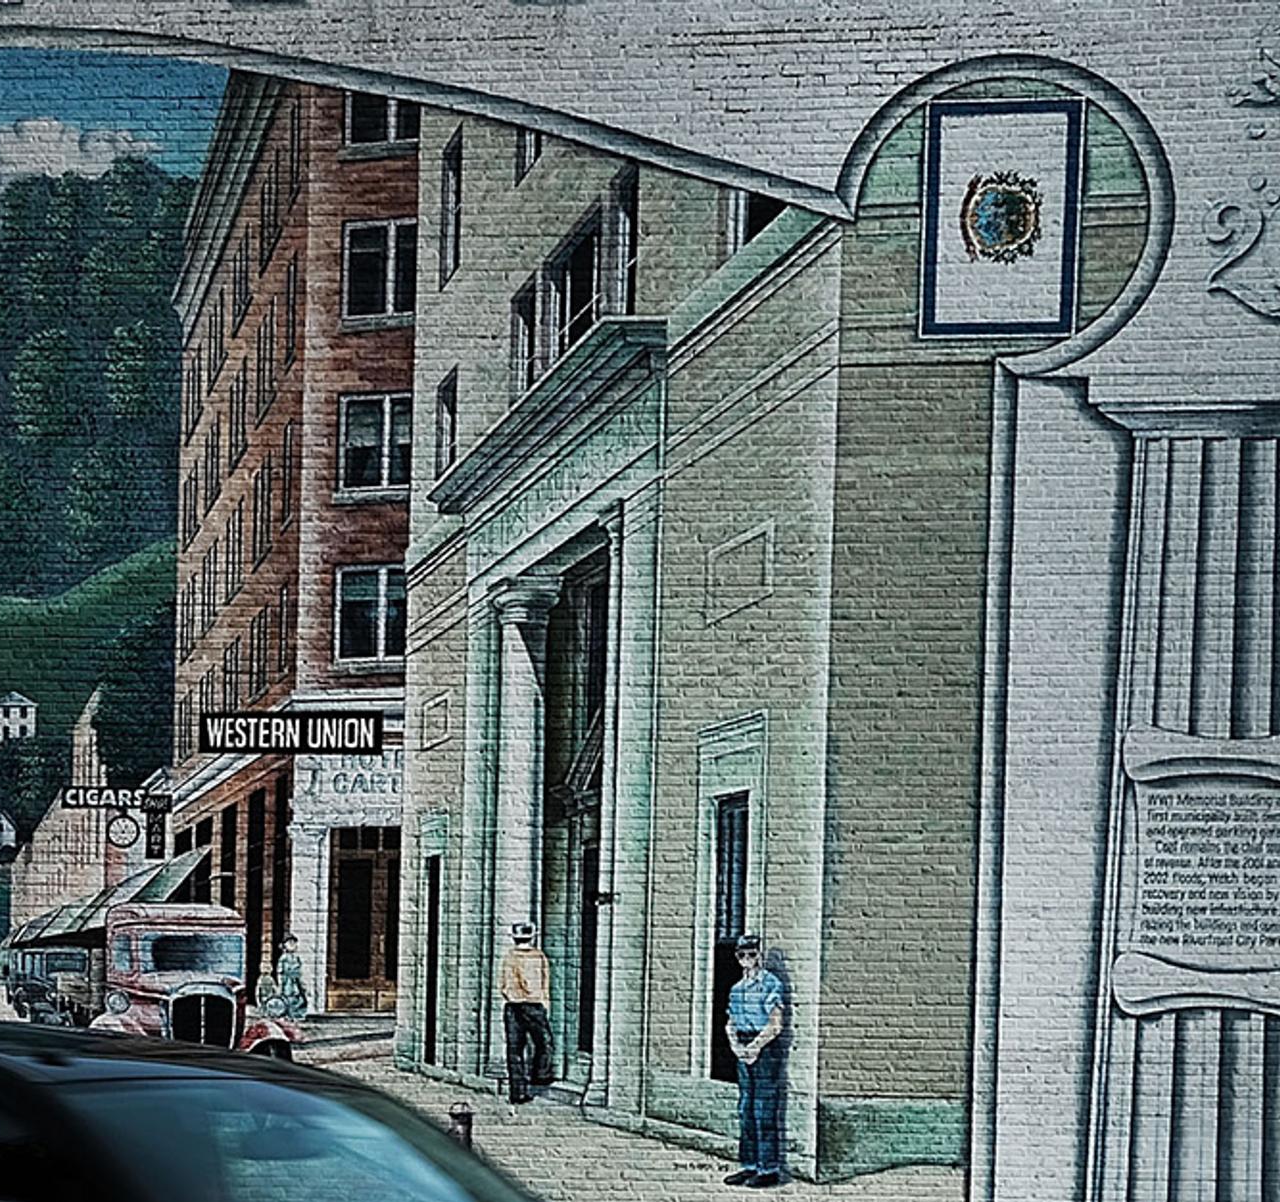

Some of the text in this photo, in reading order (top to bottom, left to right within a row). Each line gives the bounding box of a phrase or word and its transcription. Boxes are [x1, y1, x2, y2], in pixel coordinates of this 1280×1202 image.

[206, 716, 375, 749] WESTERN UNION
[65, 788, 146, 806] CIGARS
[1243, 871, 1278, 888] began
[1142, 889, 1185, 902] recovery
[1188, 888, 1206, 900] and
[1236, 934, 1257, 949] City
